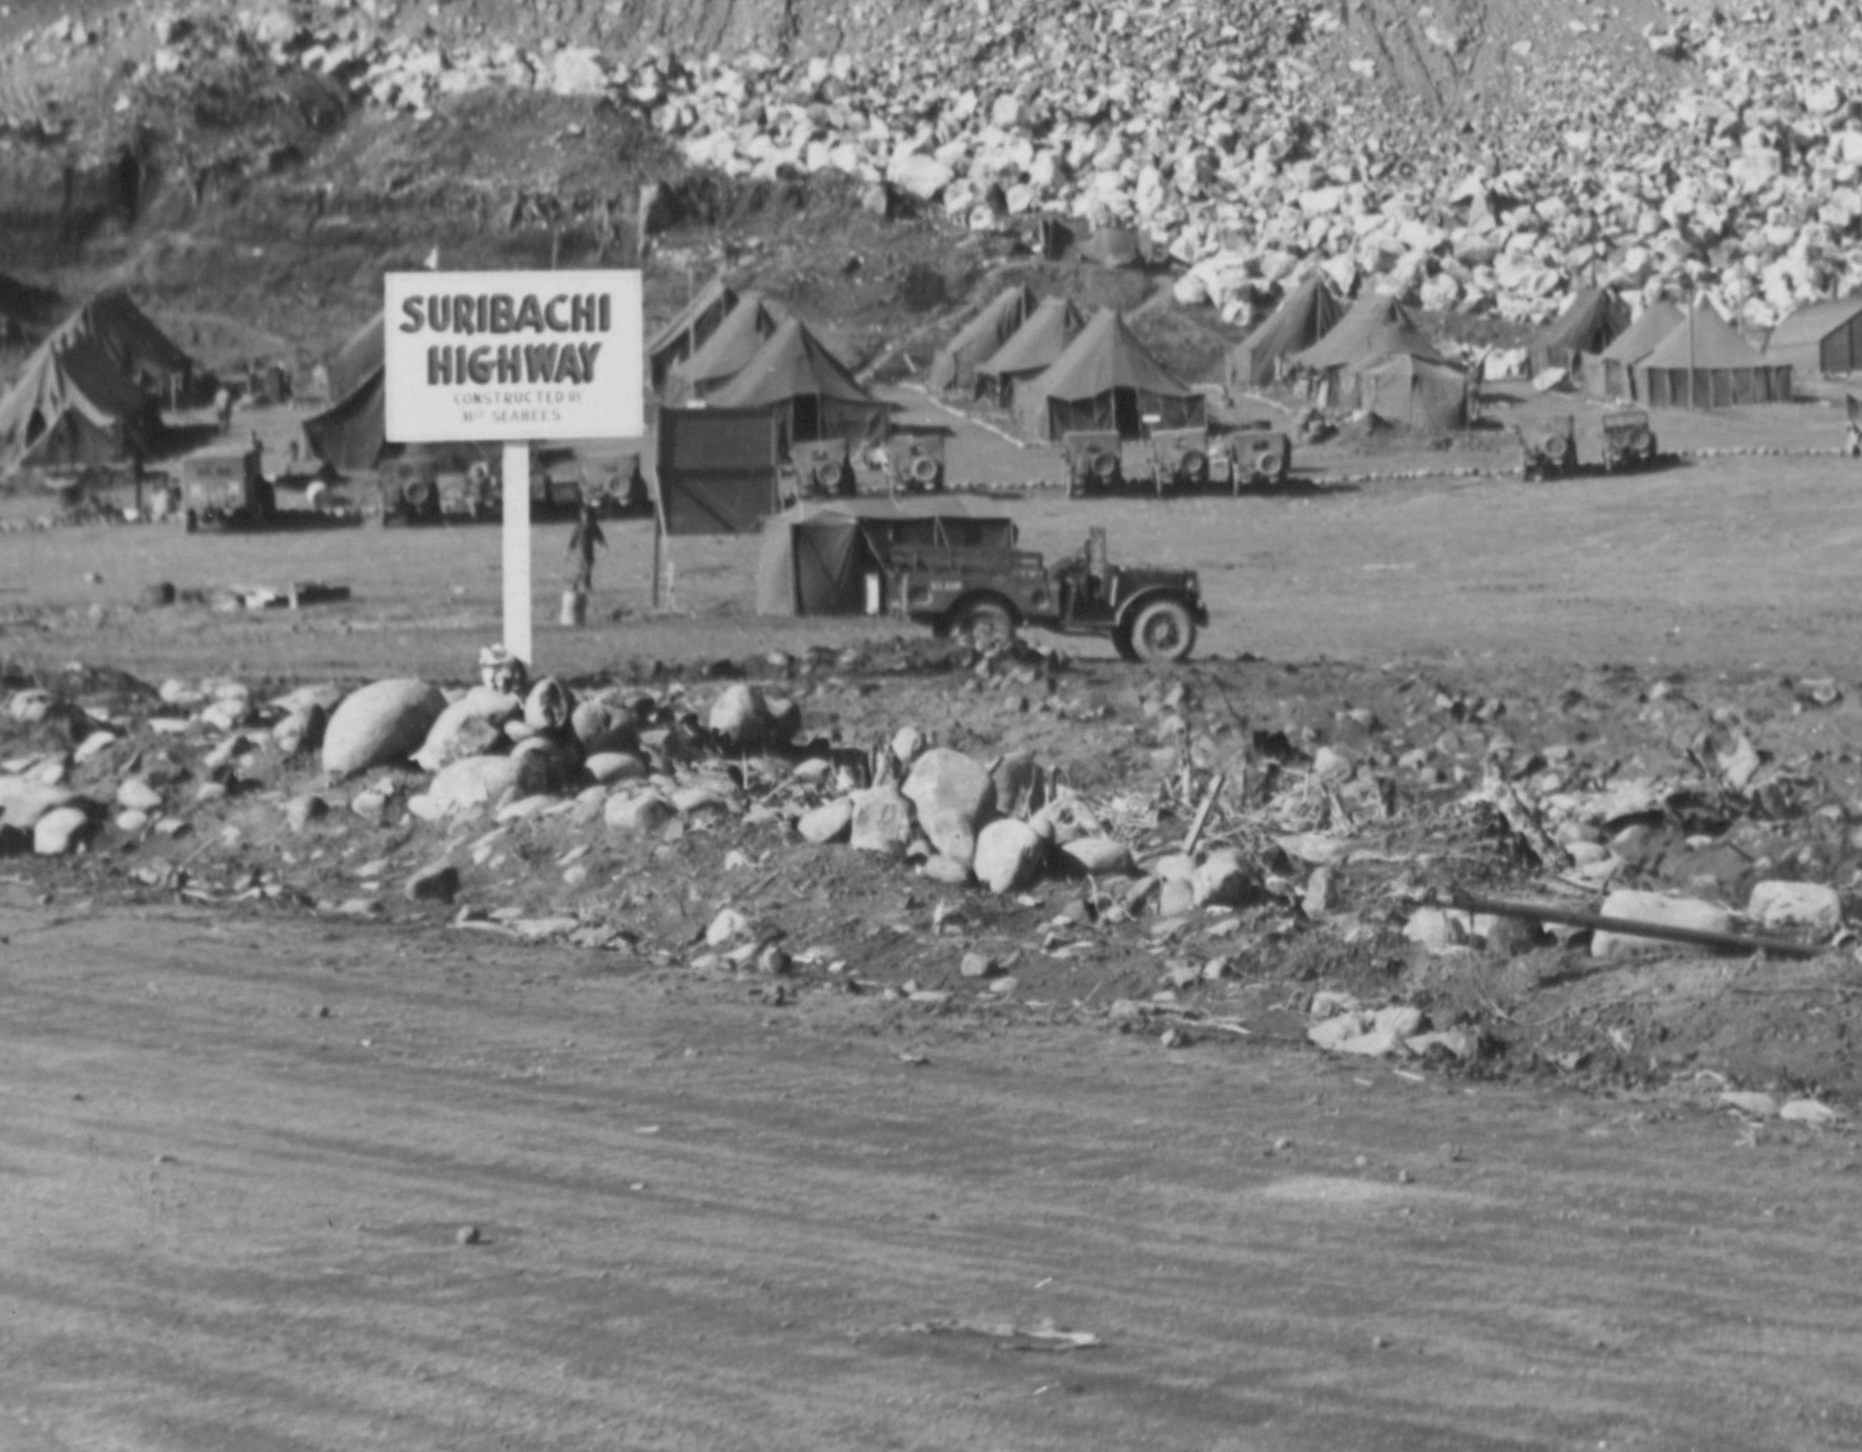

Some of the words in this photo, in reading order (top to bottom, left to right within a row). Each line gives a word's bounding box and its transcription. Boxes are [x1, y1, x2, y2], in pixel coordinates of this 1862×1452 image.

[399, 293, 611, 336] SURIBACHI
[426, 341, 602, 386] HIGHWAY
[453, 390, 565, 405] CONSTRUCTED
[491, 407, 562, 423] SEABEES
